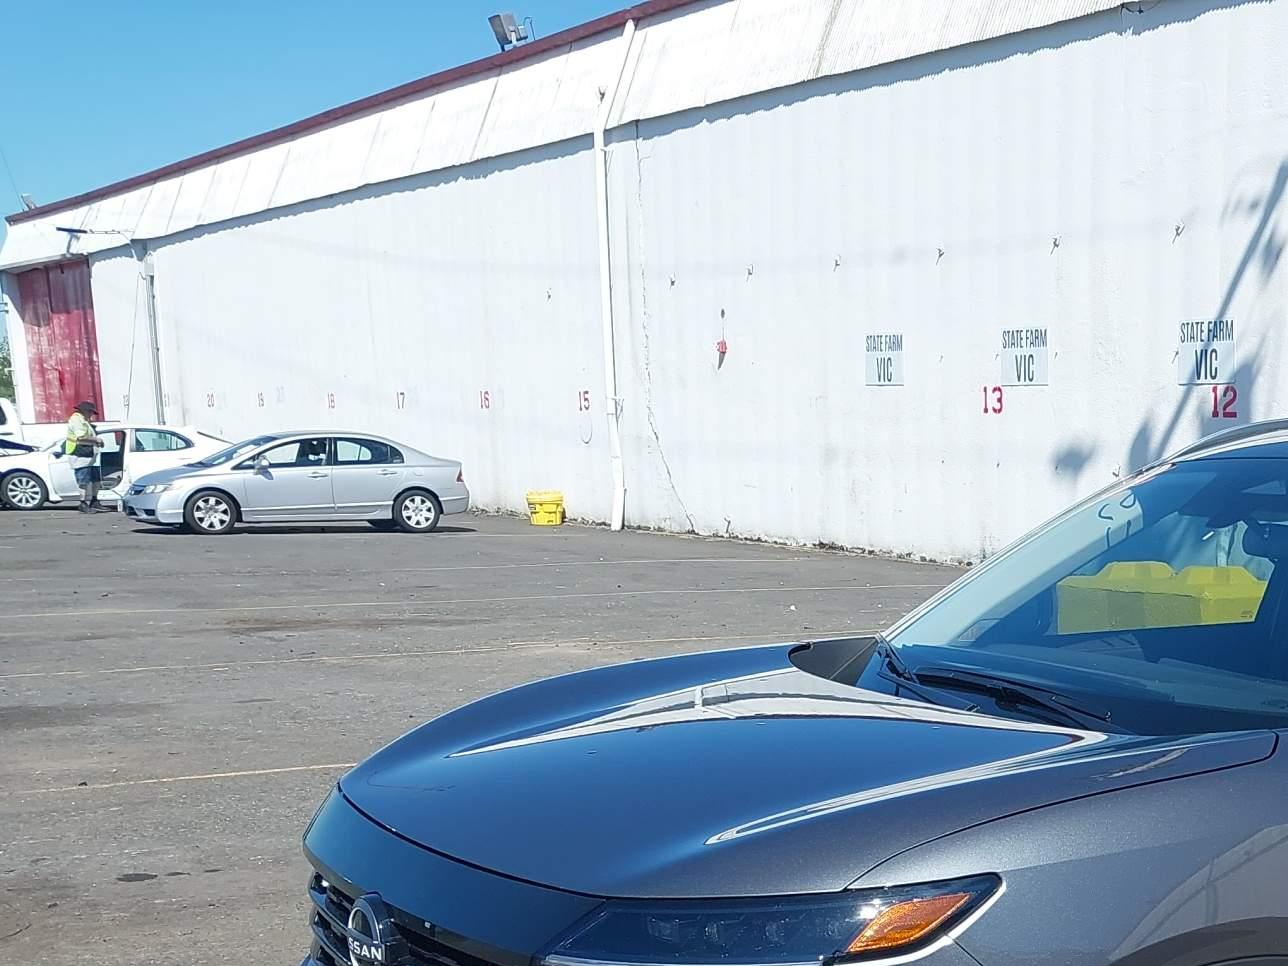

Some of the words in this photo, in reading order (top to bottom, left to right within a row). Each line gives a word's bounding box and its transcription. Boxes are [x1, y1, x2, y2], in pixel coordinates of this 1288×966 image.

[865, 335, 883, 352] STATE
[885, 334, 903, 351] FARM
[1002, 330, 1023, 349] STATE
[1026, 329, 1047, 348] FARM
[1180, 322, 1204, 344] STATE
[1207, 320, 1234, 342] FARM
[876, 357, 893, 382] VIC
[1015, 354, 1035, 382] VIC
[1195, 348, 1218, 381] VIC
[396, 391, 406, 409] 17
[480, 390, 490, 409] 16
[579, 390, 591, 411] 15
[983, 386, 1003, 414] 13
[1211, 385, 1238, 418] 12
[348, 936, 382, 961] SSAN
